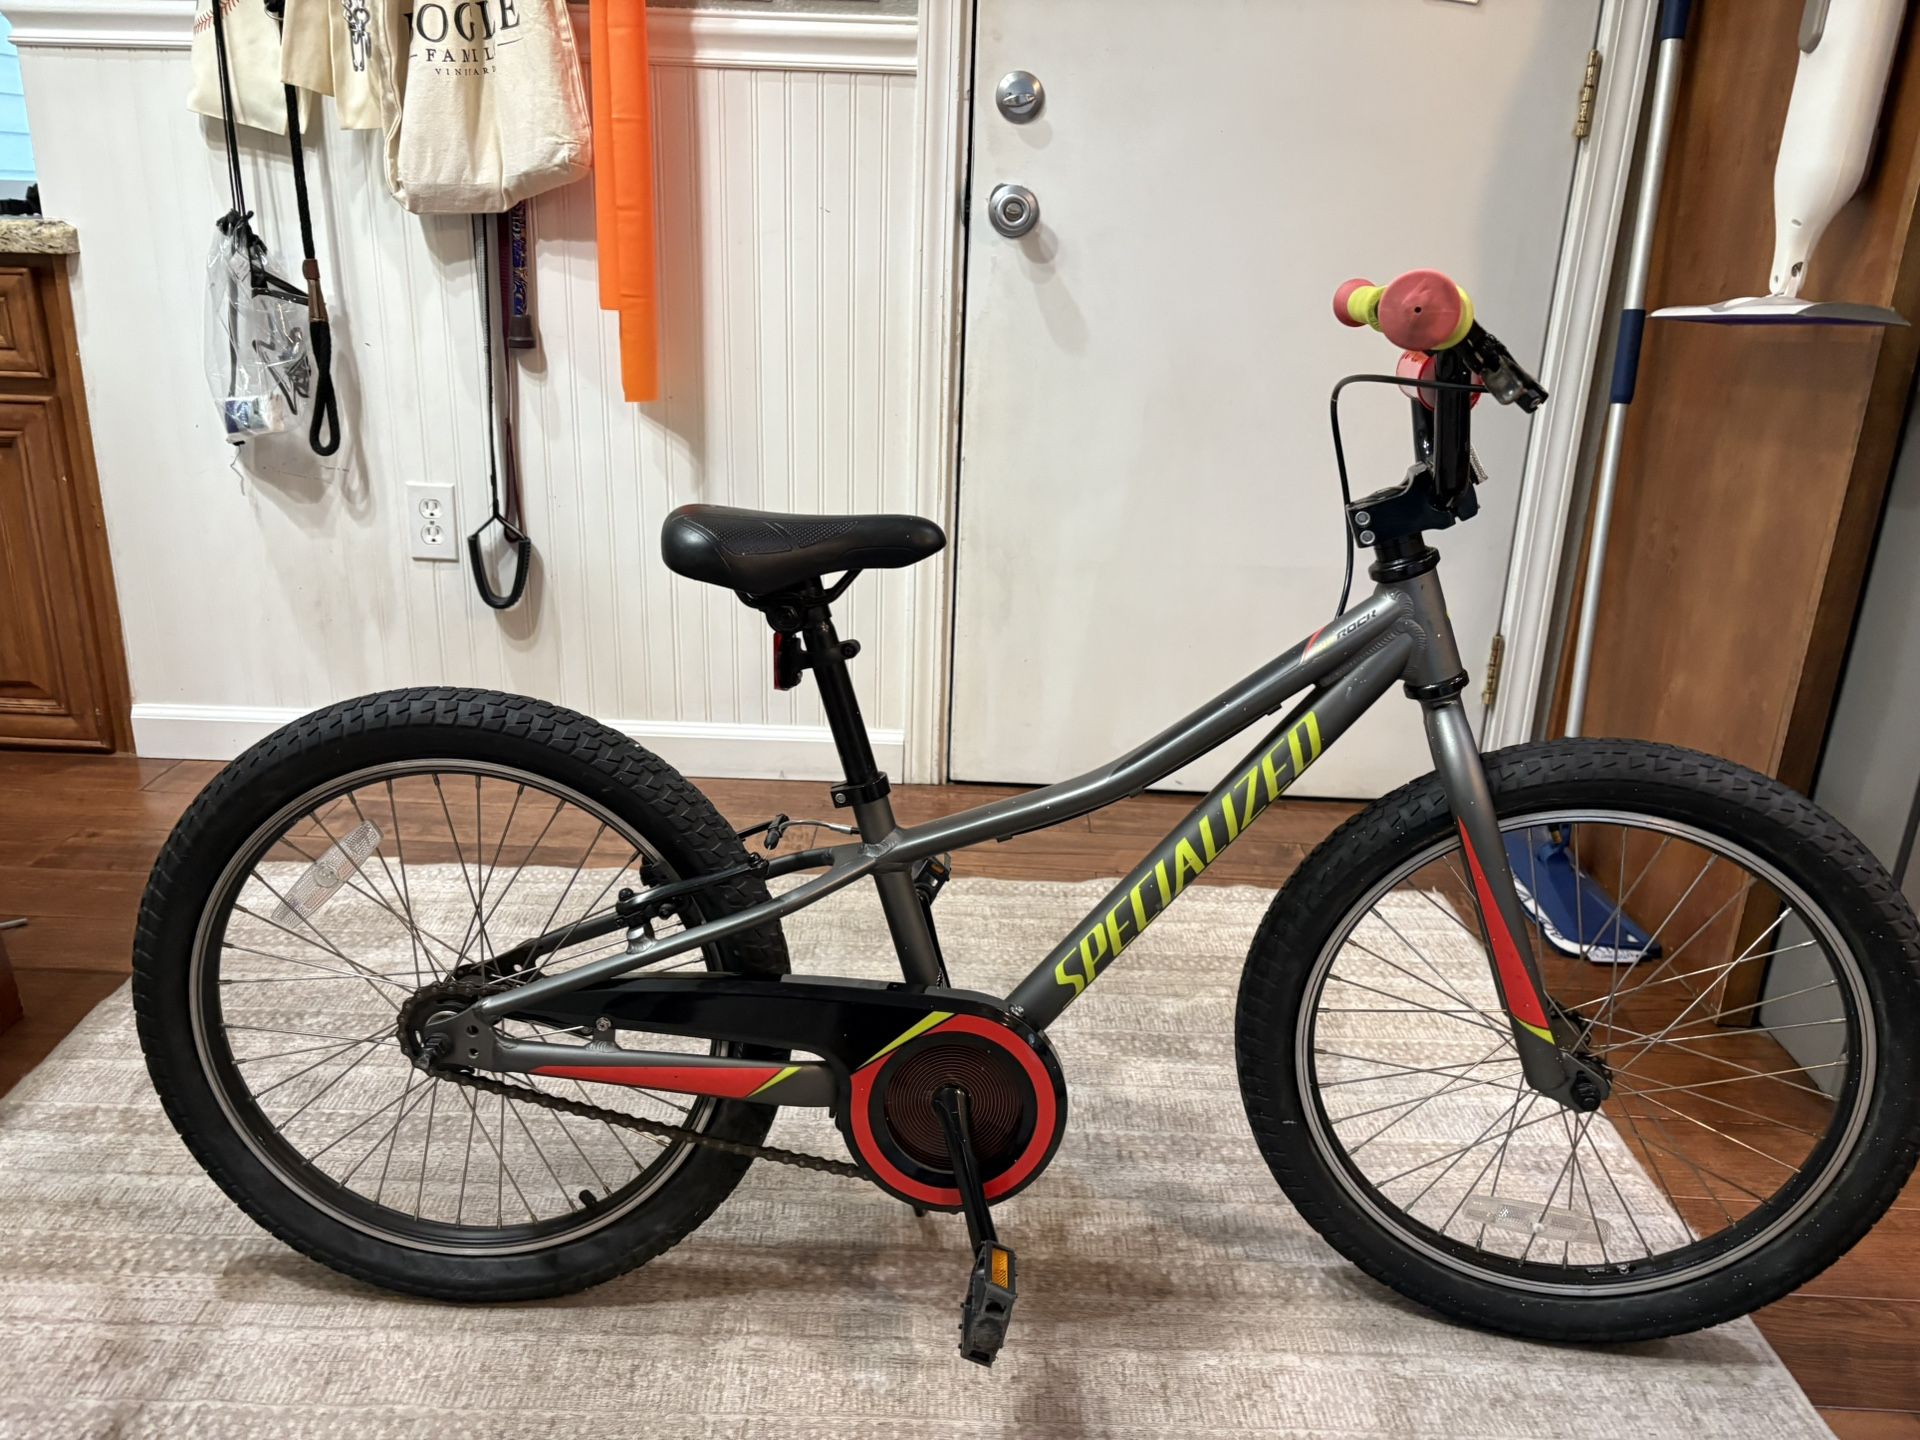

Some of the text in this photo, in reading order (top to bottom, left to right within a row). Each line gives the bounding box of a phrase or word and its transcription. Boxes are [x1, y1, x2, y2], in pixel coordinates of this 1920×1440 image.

[404, 0, 520, 43] OGLE
[425, 45, 496, 63] FAMIL
[1054, 710, 1322, 1009] SPECIALIZED
